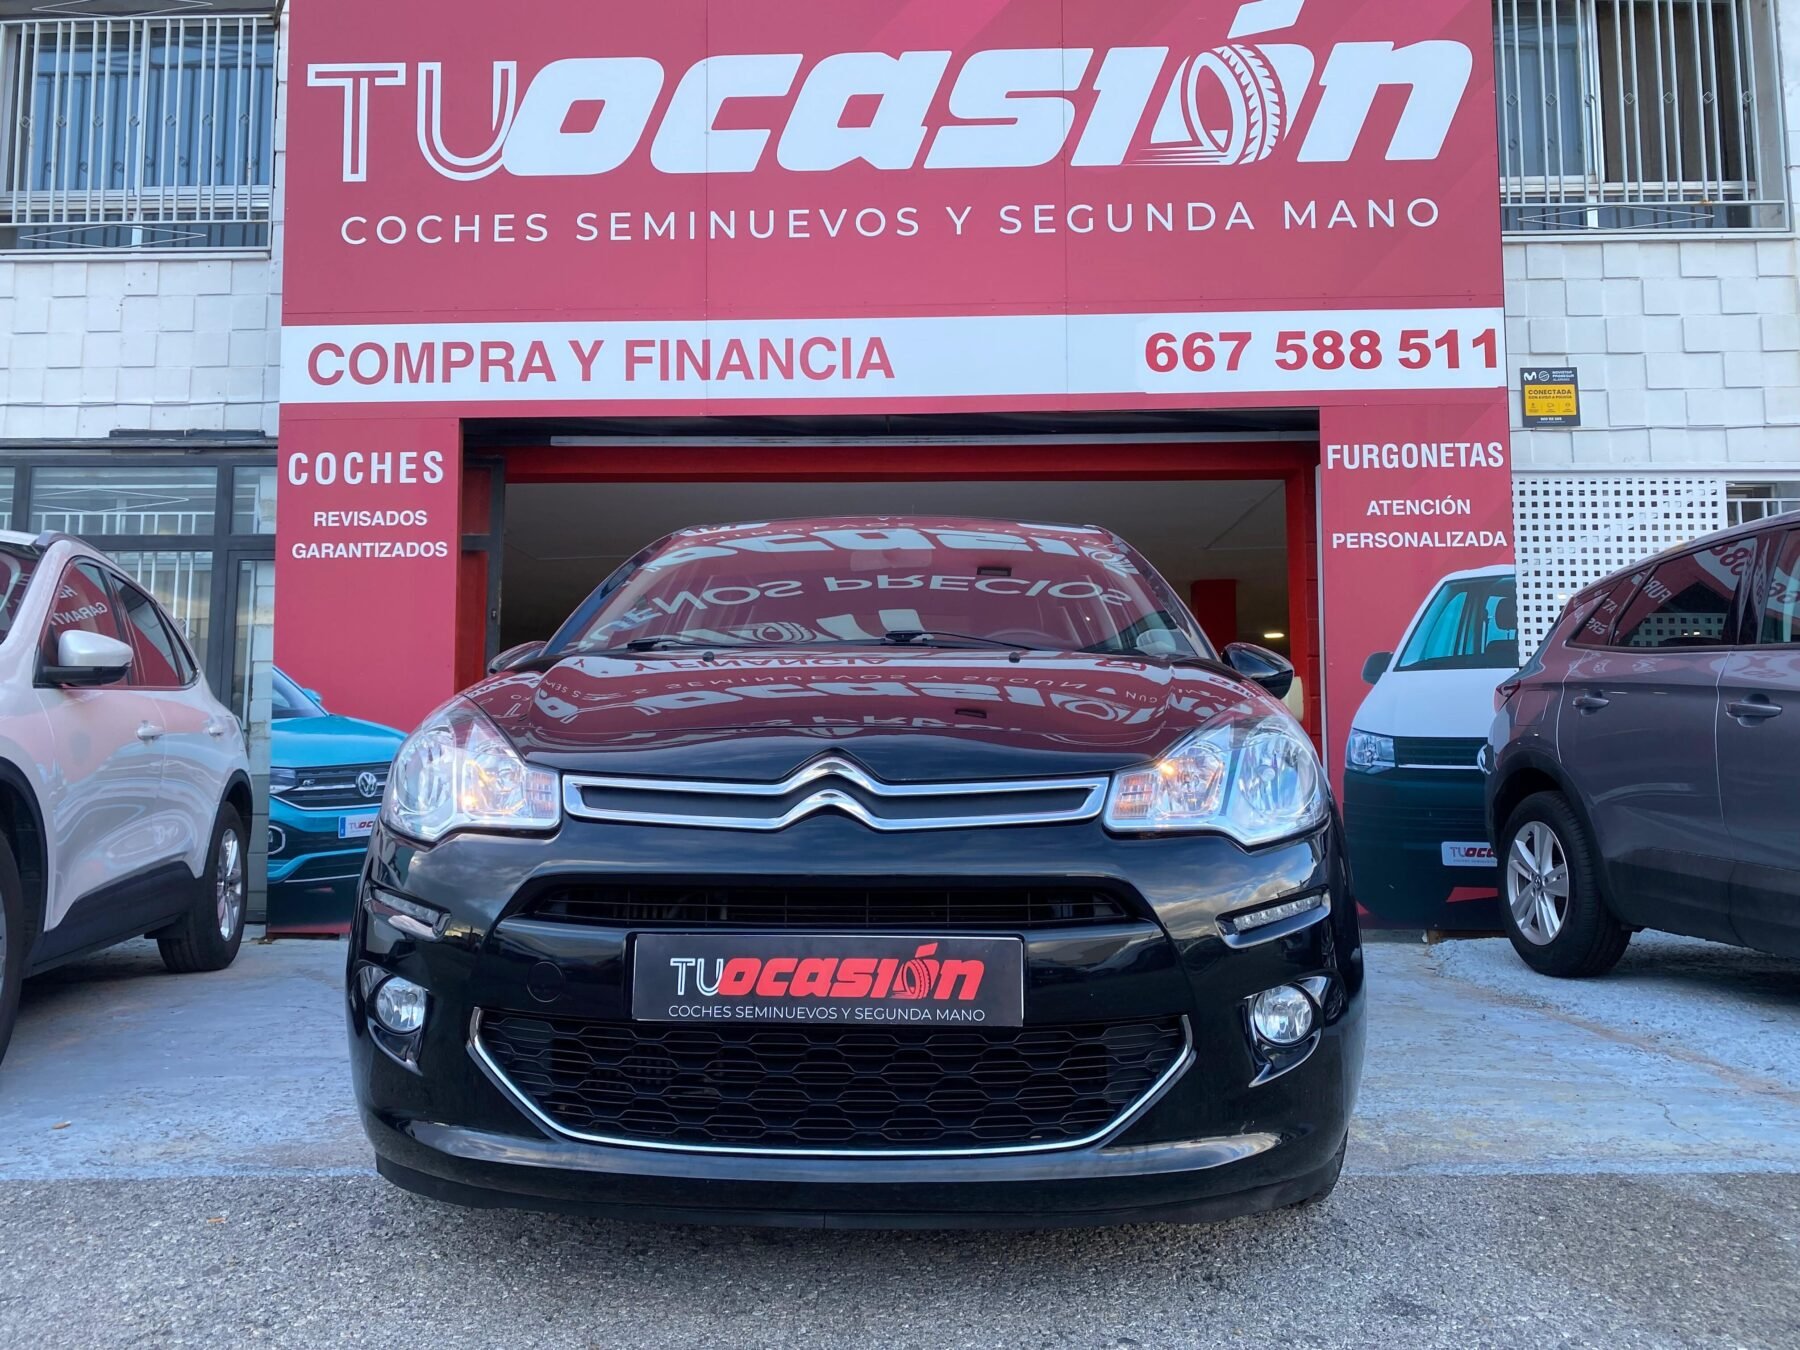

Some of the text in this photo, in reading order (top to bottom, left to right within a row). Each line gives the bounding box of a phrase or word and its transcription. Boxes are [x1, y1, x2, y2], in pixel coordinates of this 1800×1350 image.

[341, 198, 1439, 245] COCHES SEMINUEVOS Y SEGUNDA MANO
[307, 336, 895, 386] COMPRA Y FINANCIA
[1145, 328, 1497, 372] 667 588 511
[1327, 442, 1504, 469] FURGONETAS
[288, 451, 443, 485] COCHES
[1367, 495, 1471, 516] ATENCIÓN
[314, 510, 428, 526] REVISADOS
[292, 541, 448, 558] GARANTIZADOS
[1332, 531, 1507, 549] PERSONALIZADA
[668, 1005, 985, 1021] COCHES SEMINUEVOS Y SEGUNDA MANO
